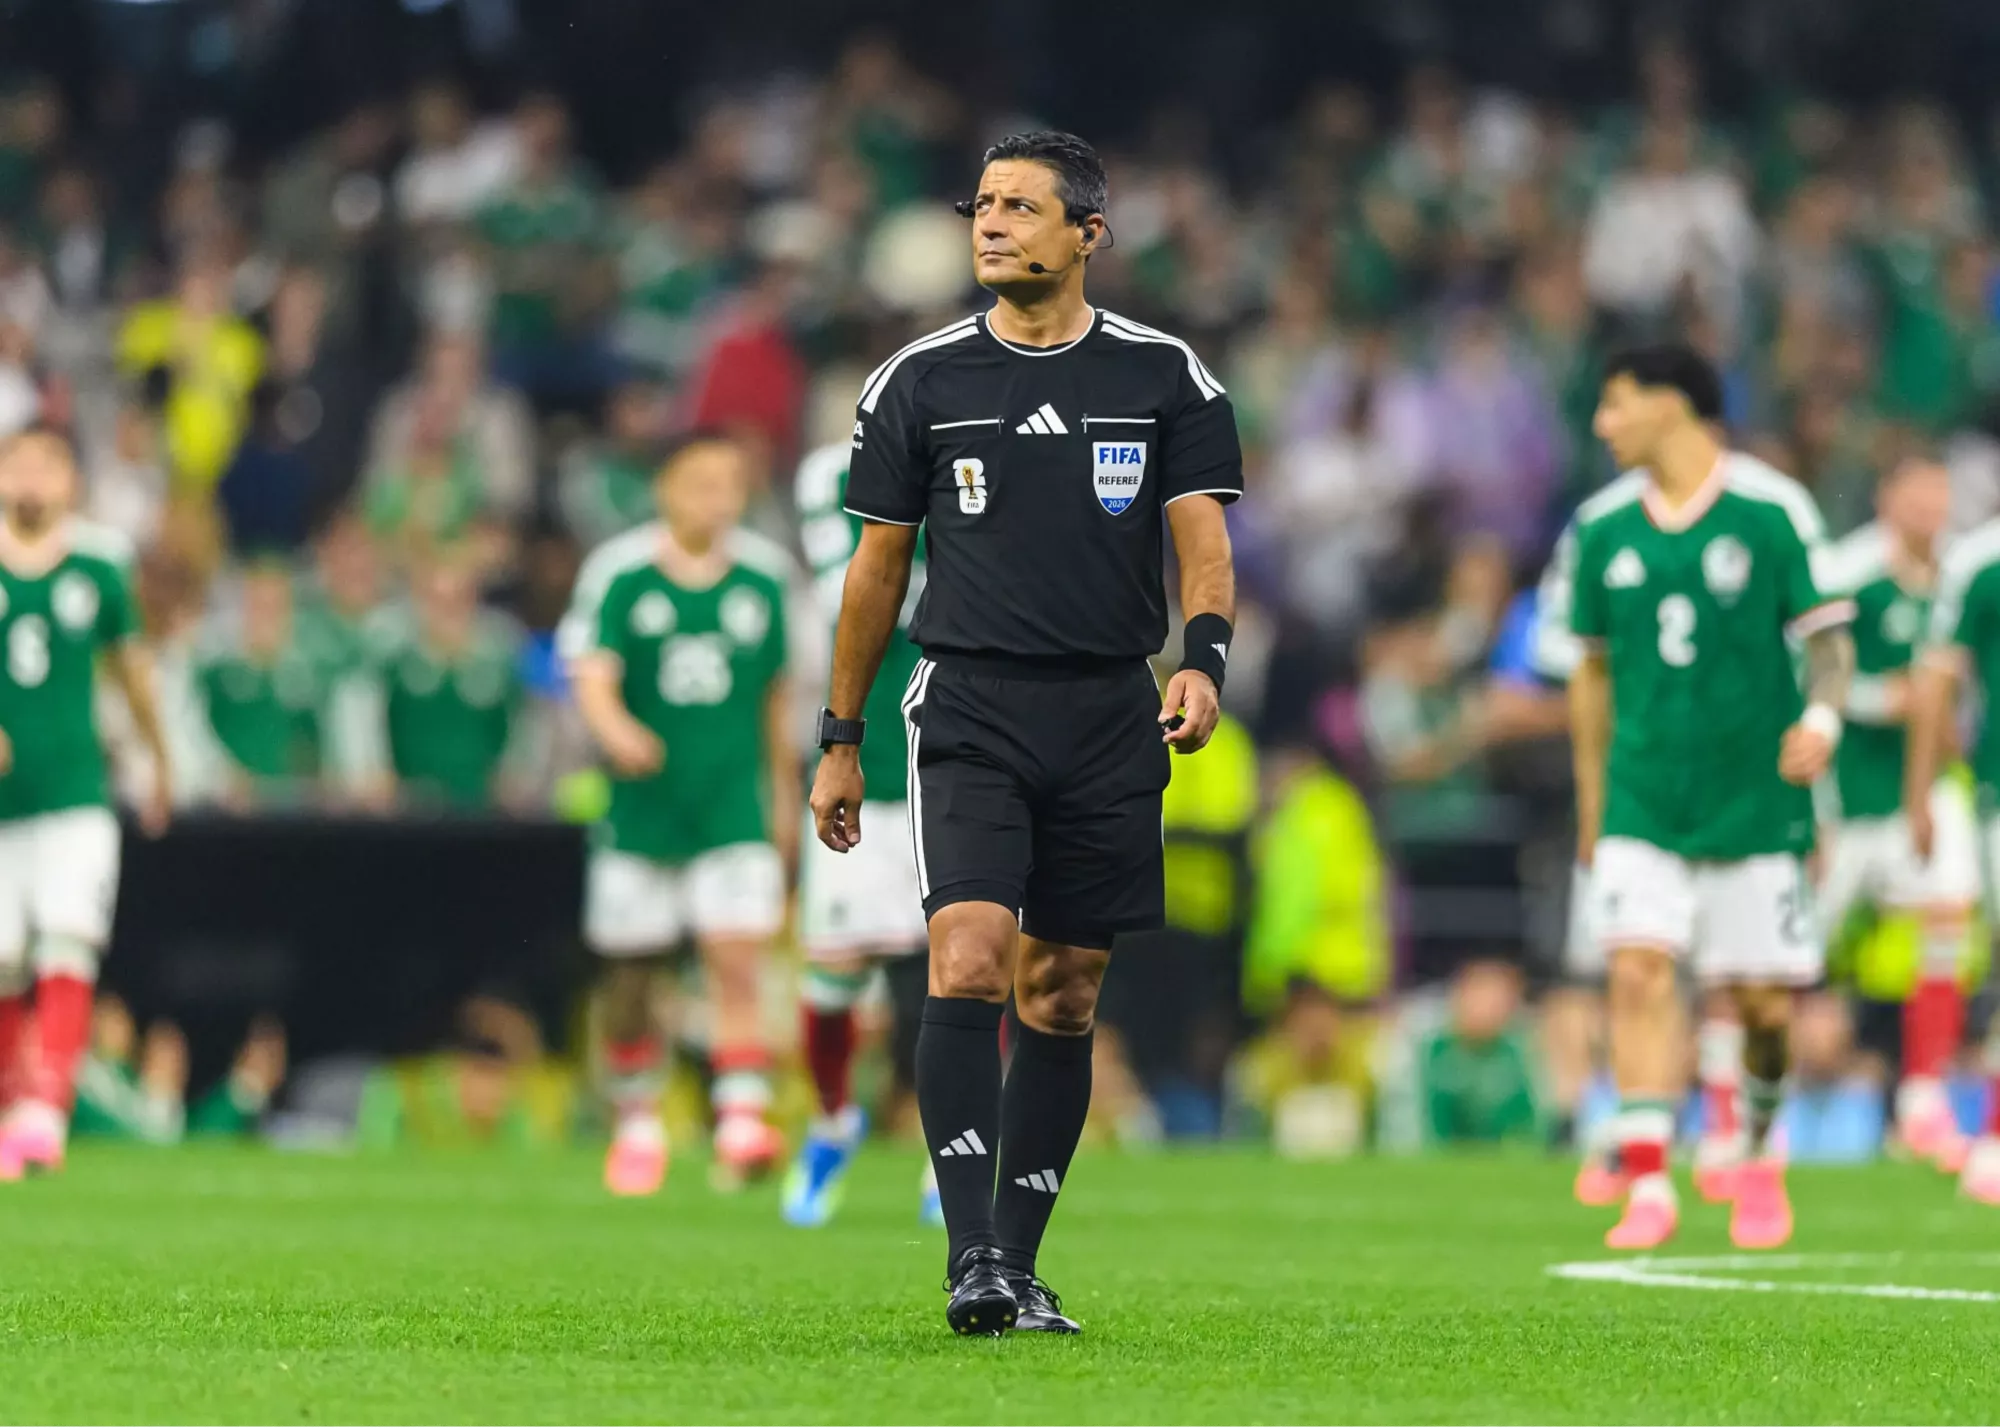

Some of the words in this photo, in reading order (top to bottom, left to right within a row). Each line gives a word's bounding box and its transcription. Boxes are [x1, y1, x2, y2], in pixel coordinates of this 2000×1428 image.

[1099, 447, 1141, 464] FIFA
[1098, 476, 1138, 485] REFEREE
[1108, 500, 1126, 508] 2026
[1657, 592, 1697, 667] 2
[8, 613, 50, 688] 6
